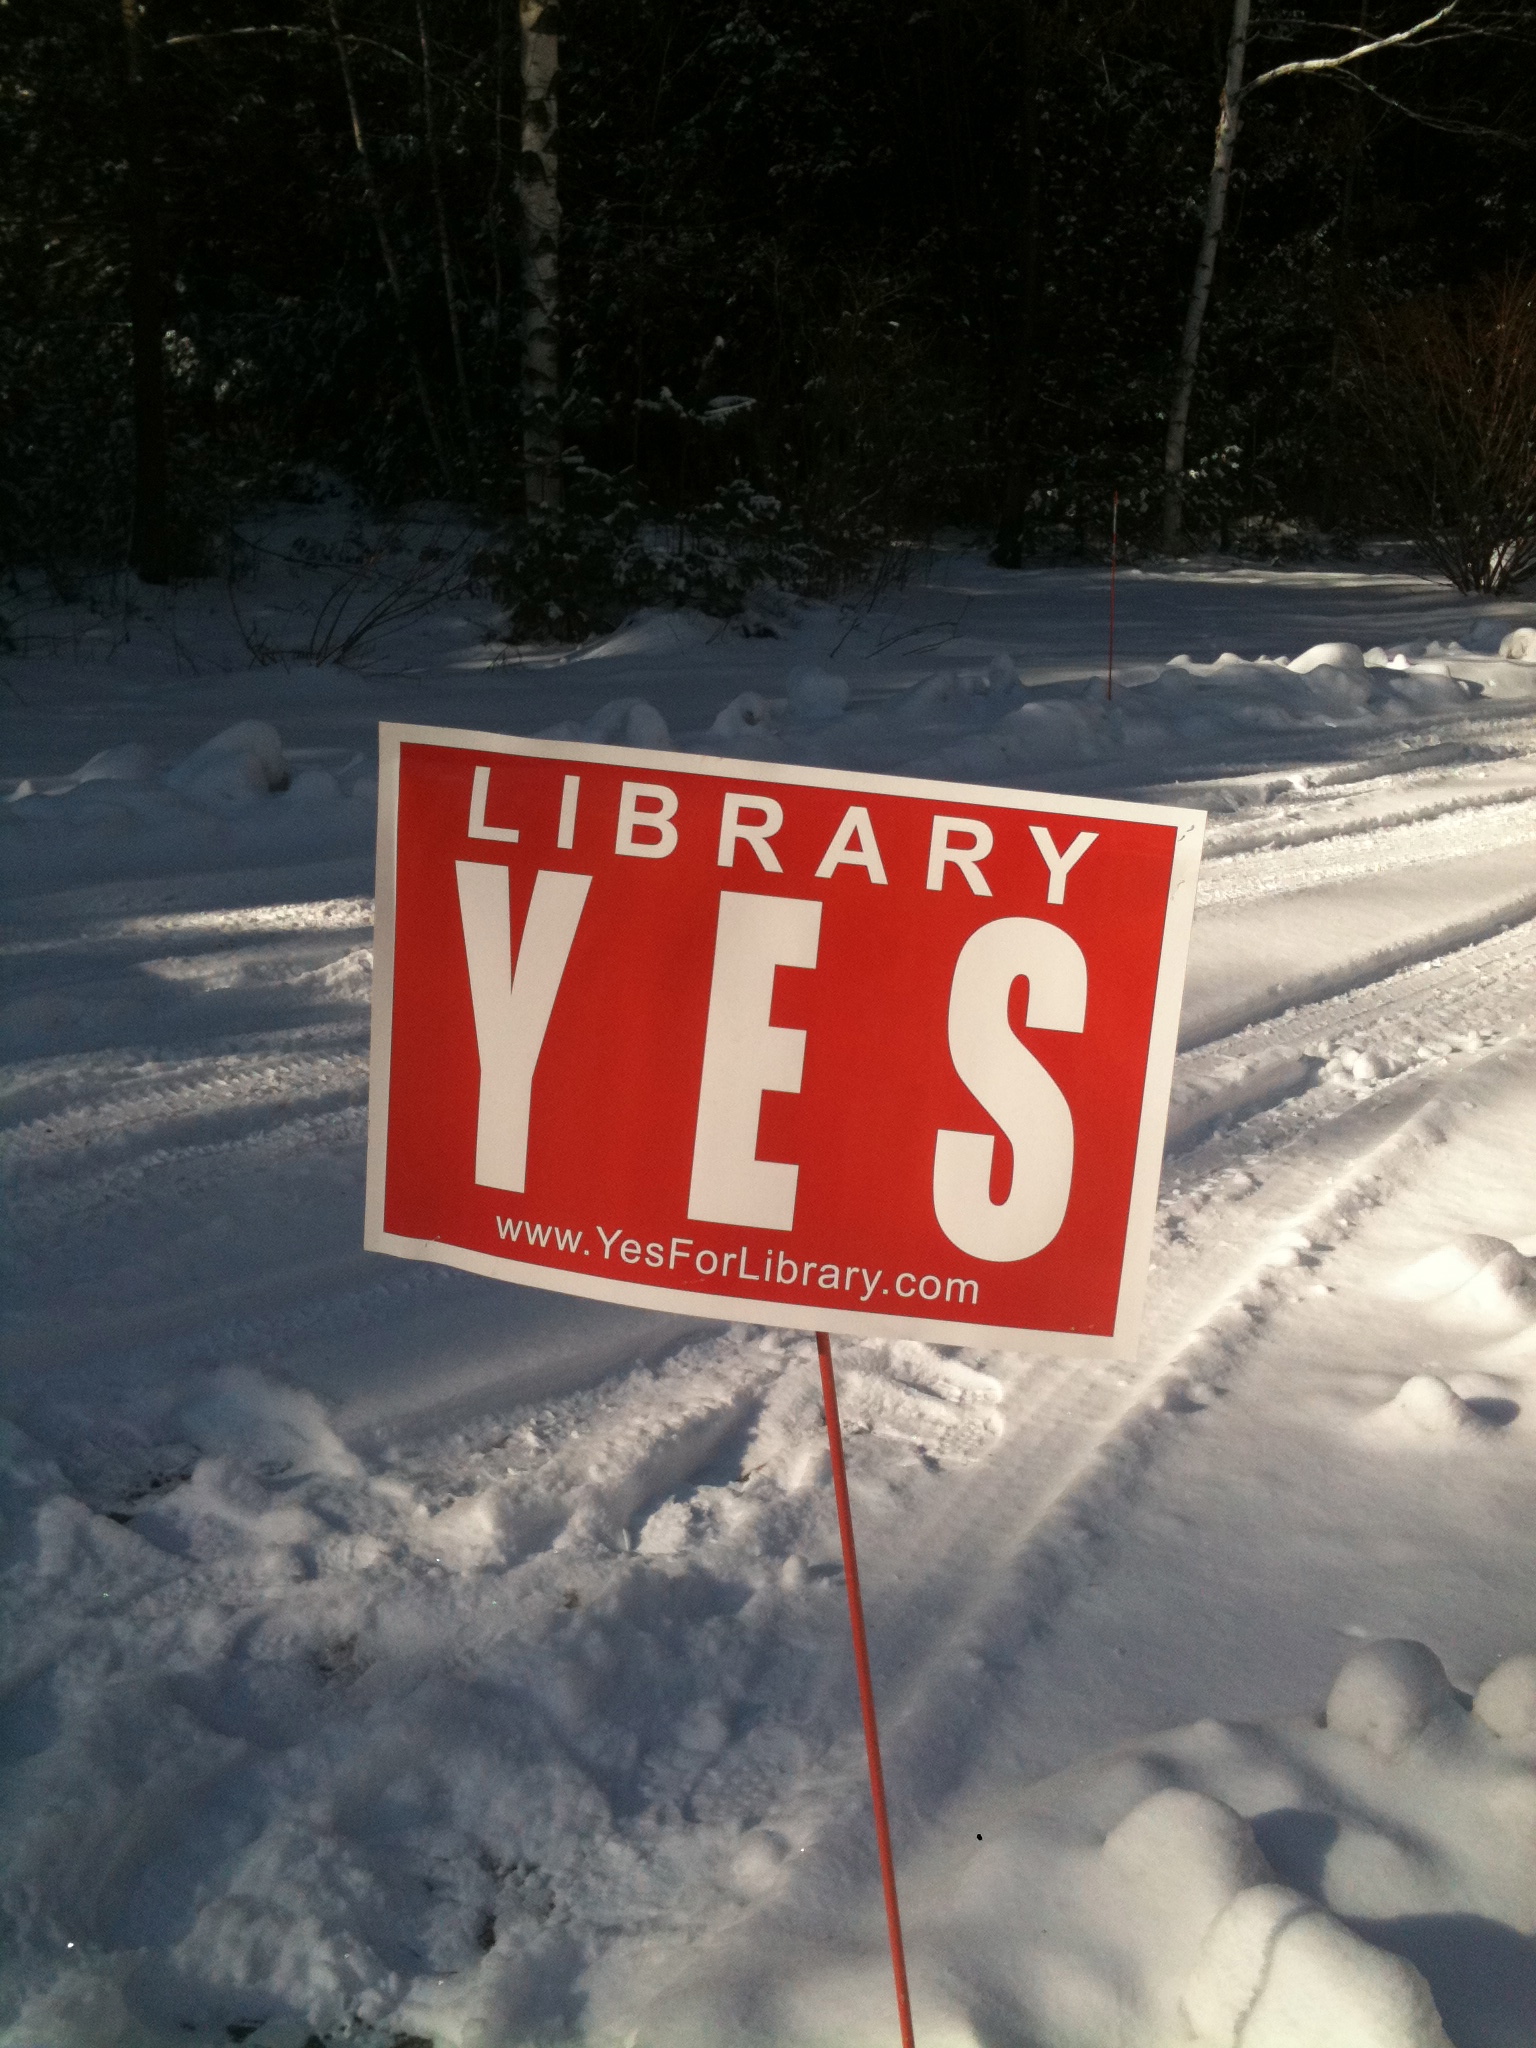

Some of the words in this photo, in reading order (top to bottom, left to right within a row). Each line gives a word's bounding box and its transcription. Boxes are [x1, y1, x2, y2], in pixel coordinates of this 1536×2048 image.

[467, 765, 1100, 905] LIBRARY
[455, 859, 1088, 1263] YES
[495, 1214, 980, 1305] www.YesForLibrary.com
